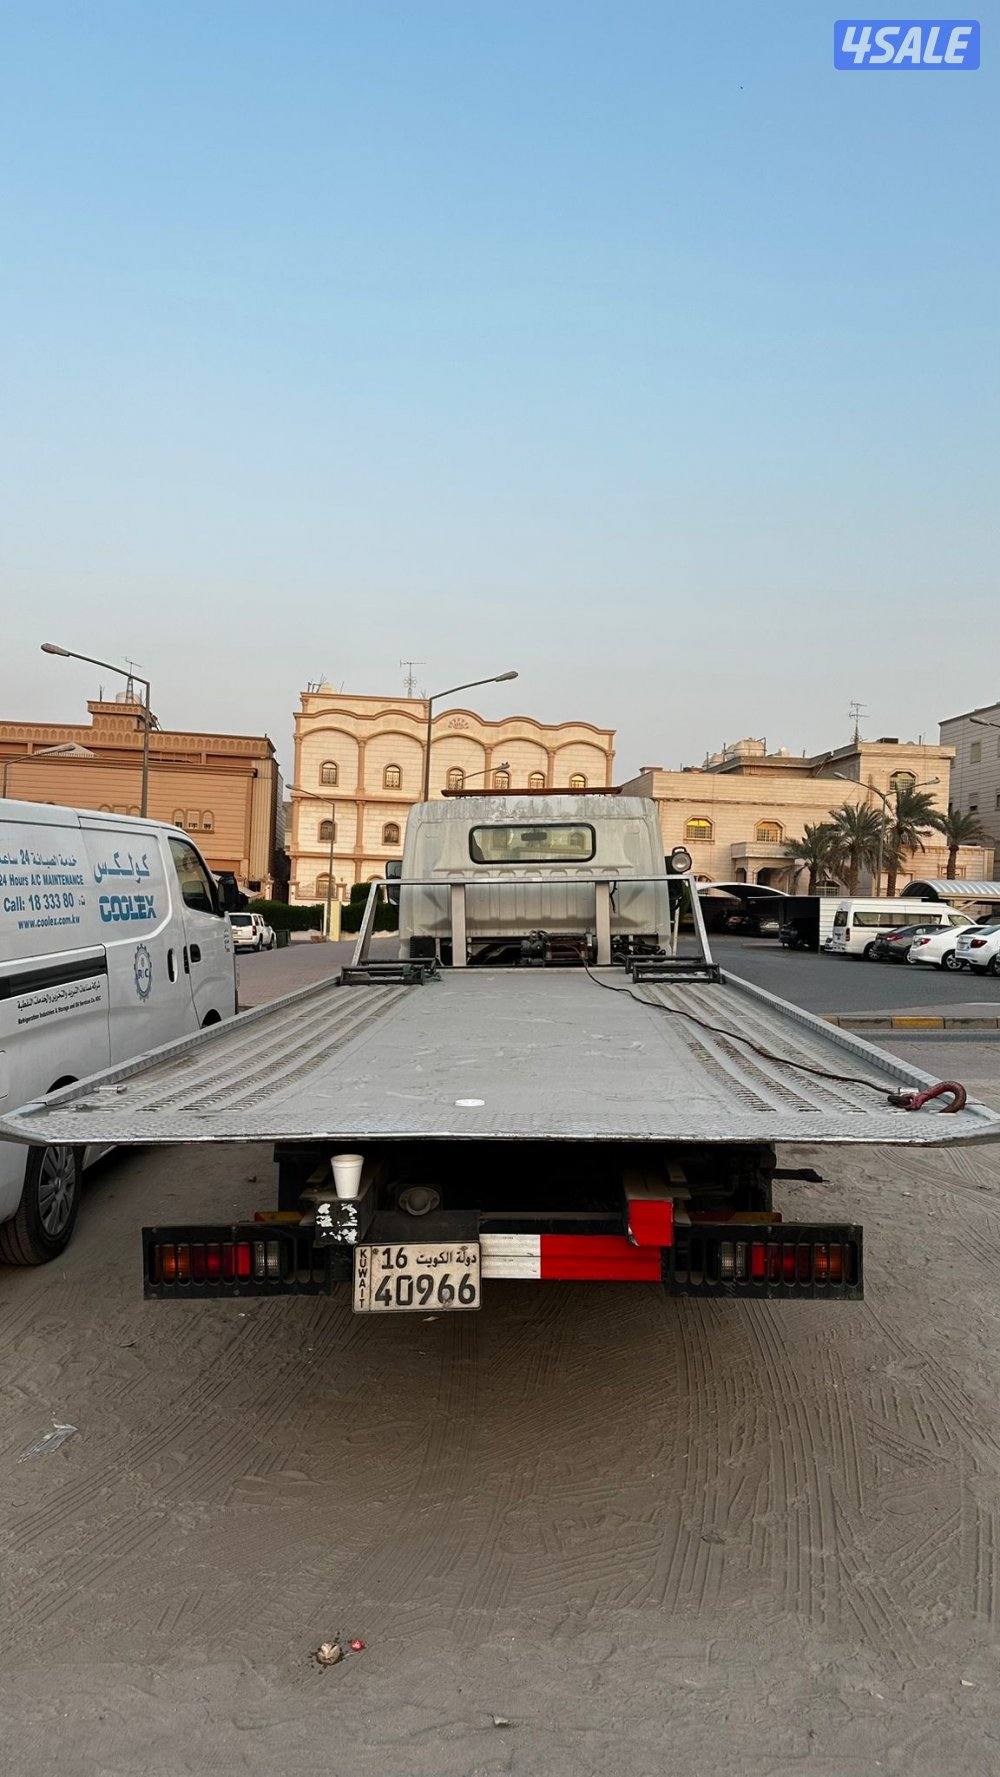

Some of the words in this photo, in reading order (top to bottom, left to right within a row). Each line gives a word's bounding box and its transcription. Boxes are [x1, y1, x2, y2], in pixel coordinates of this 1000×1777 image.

[20, 848, 30, 865] 24
[32, 852, 60, 869] الصيانة
[60, 854, 77, 867] خدمة
[93, 851, 150, 884] كولكس
[9, 874, 29, 886] Hours
[43, 874, 84, 886] MAINTENANCE
[4, 896, 25, 912] Call:
[29, 894, 41, 911] 18
[43, 893, 61, 910] 333
[63, 892, 74, 908] 80
[99, 895, 157, 922] COOLEX
[18, 914, 80, 929] www.coolex.com.kw
[381, 1247, 408, 1270] 16
[416, 1251, 453, 1268] الكويت
[455, 1250, 478, 1267] دولة
[359, 1248, 368, 1309] KUWAIT
[375, 1273, 476, 1307] 40966
